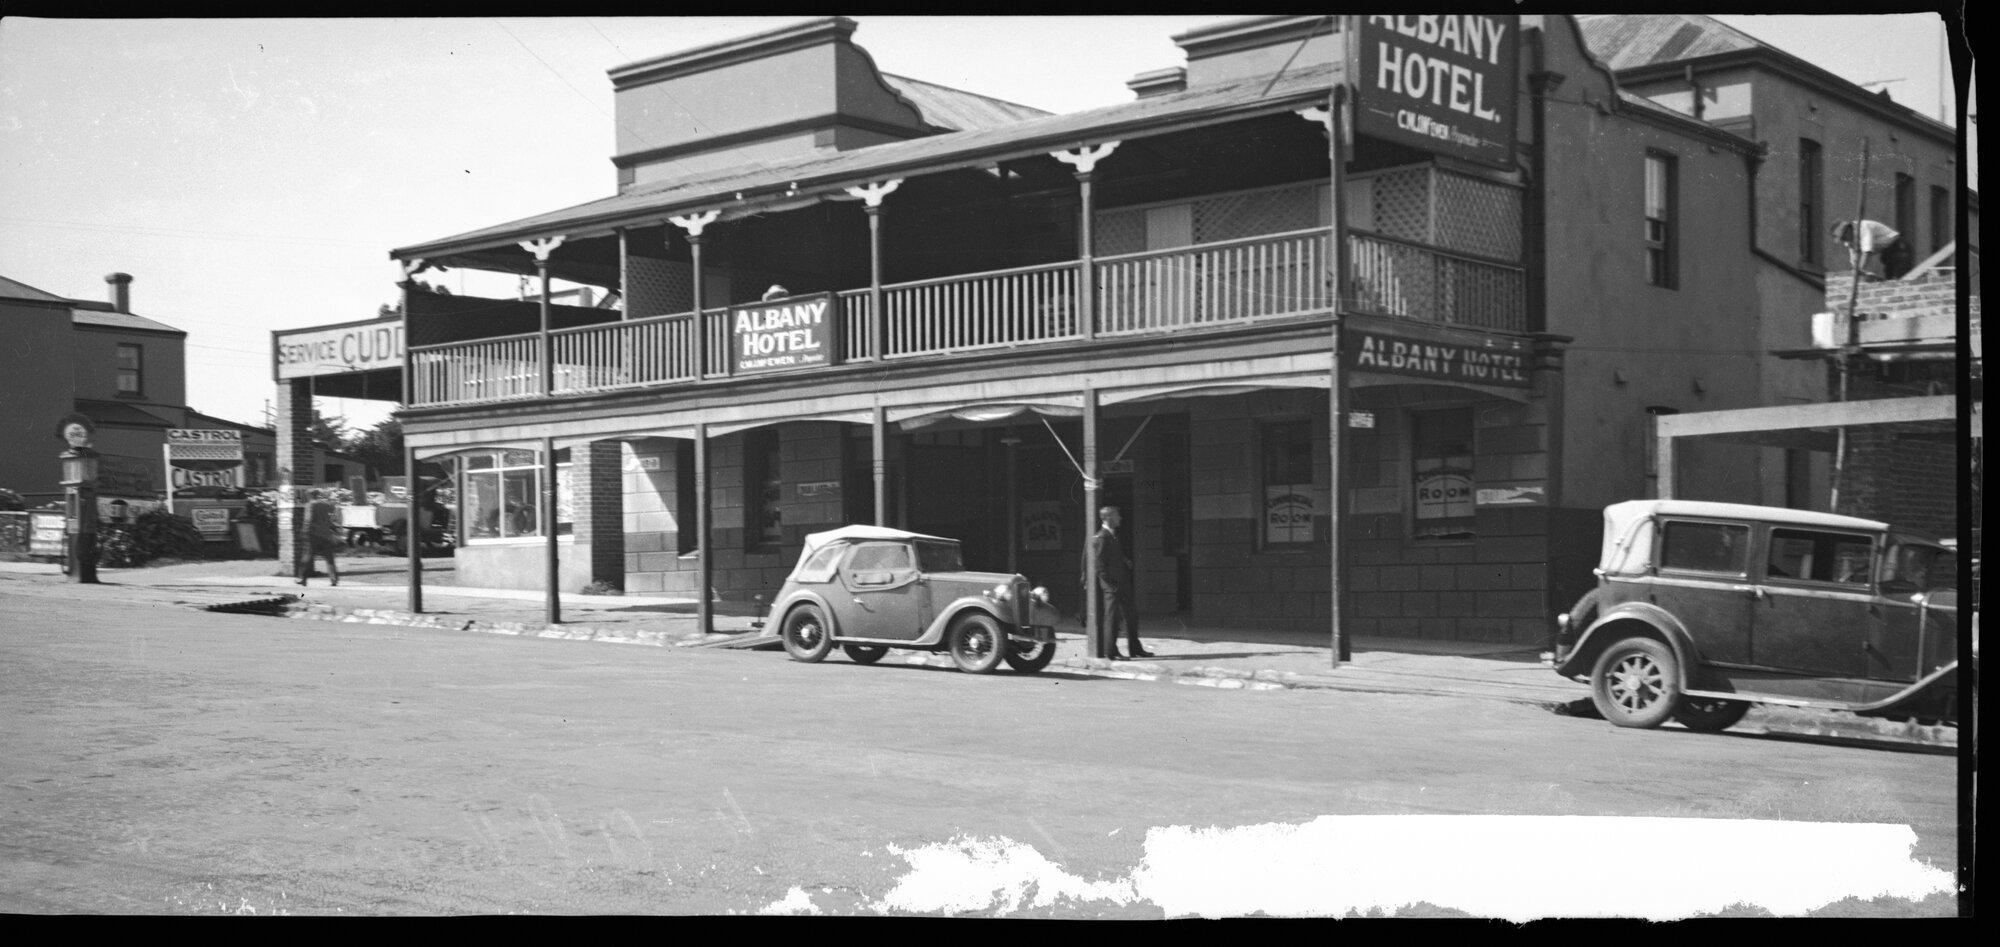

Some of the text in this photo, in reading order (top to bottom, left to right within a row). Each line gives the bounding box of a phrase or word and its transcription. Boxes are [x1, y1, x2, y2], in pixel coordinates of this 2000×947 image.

[1376, 41, 1502, 124] HOTEL.
[734, 301, 828, 333] ALBANY
[278, 339, 337, 365] SERVICE
[742, 328, 822, 356] HOTEL
[1358, 336, 1456, 374] ALBANY
[168, 429, 241, 440] CASTROL
[171, 467, 237, 489] CASTROL
[1419, 487, 1470, 500] ROOM
[1270, 512, 1312, 524] ROOM
